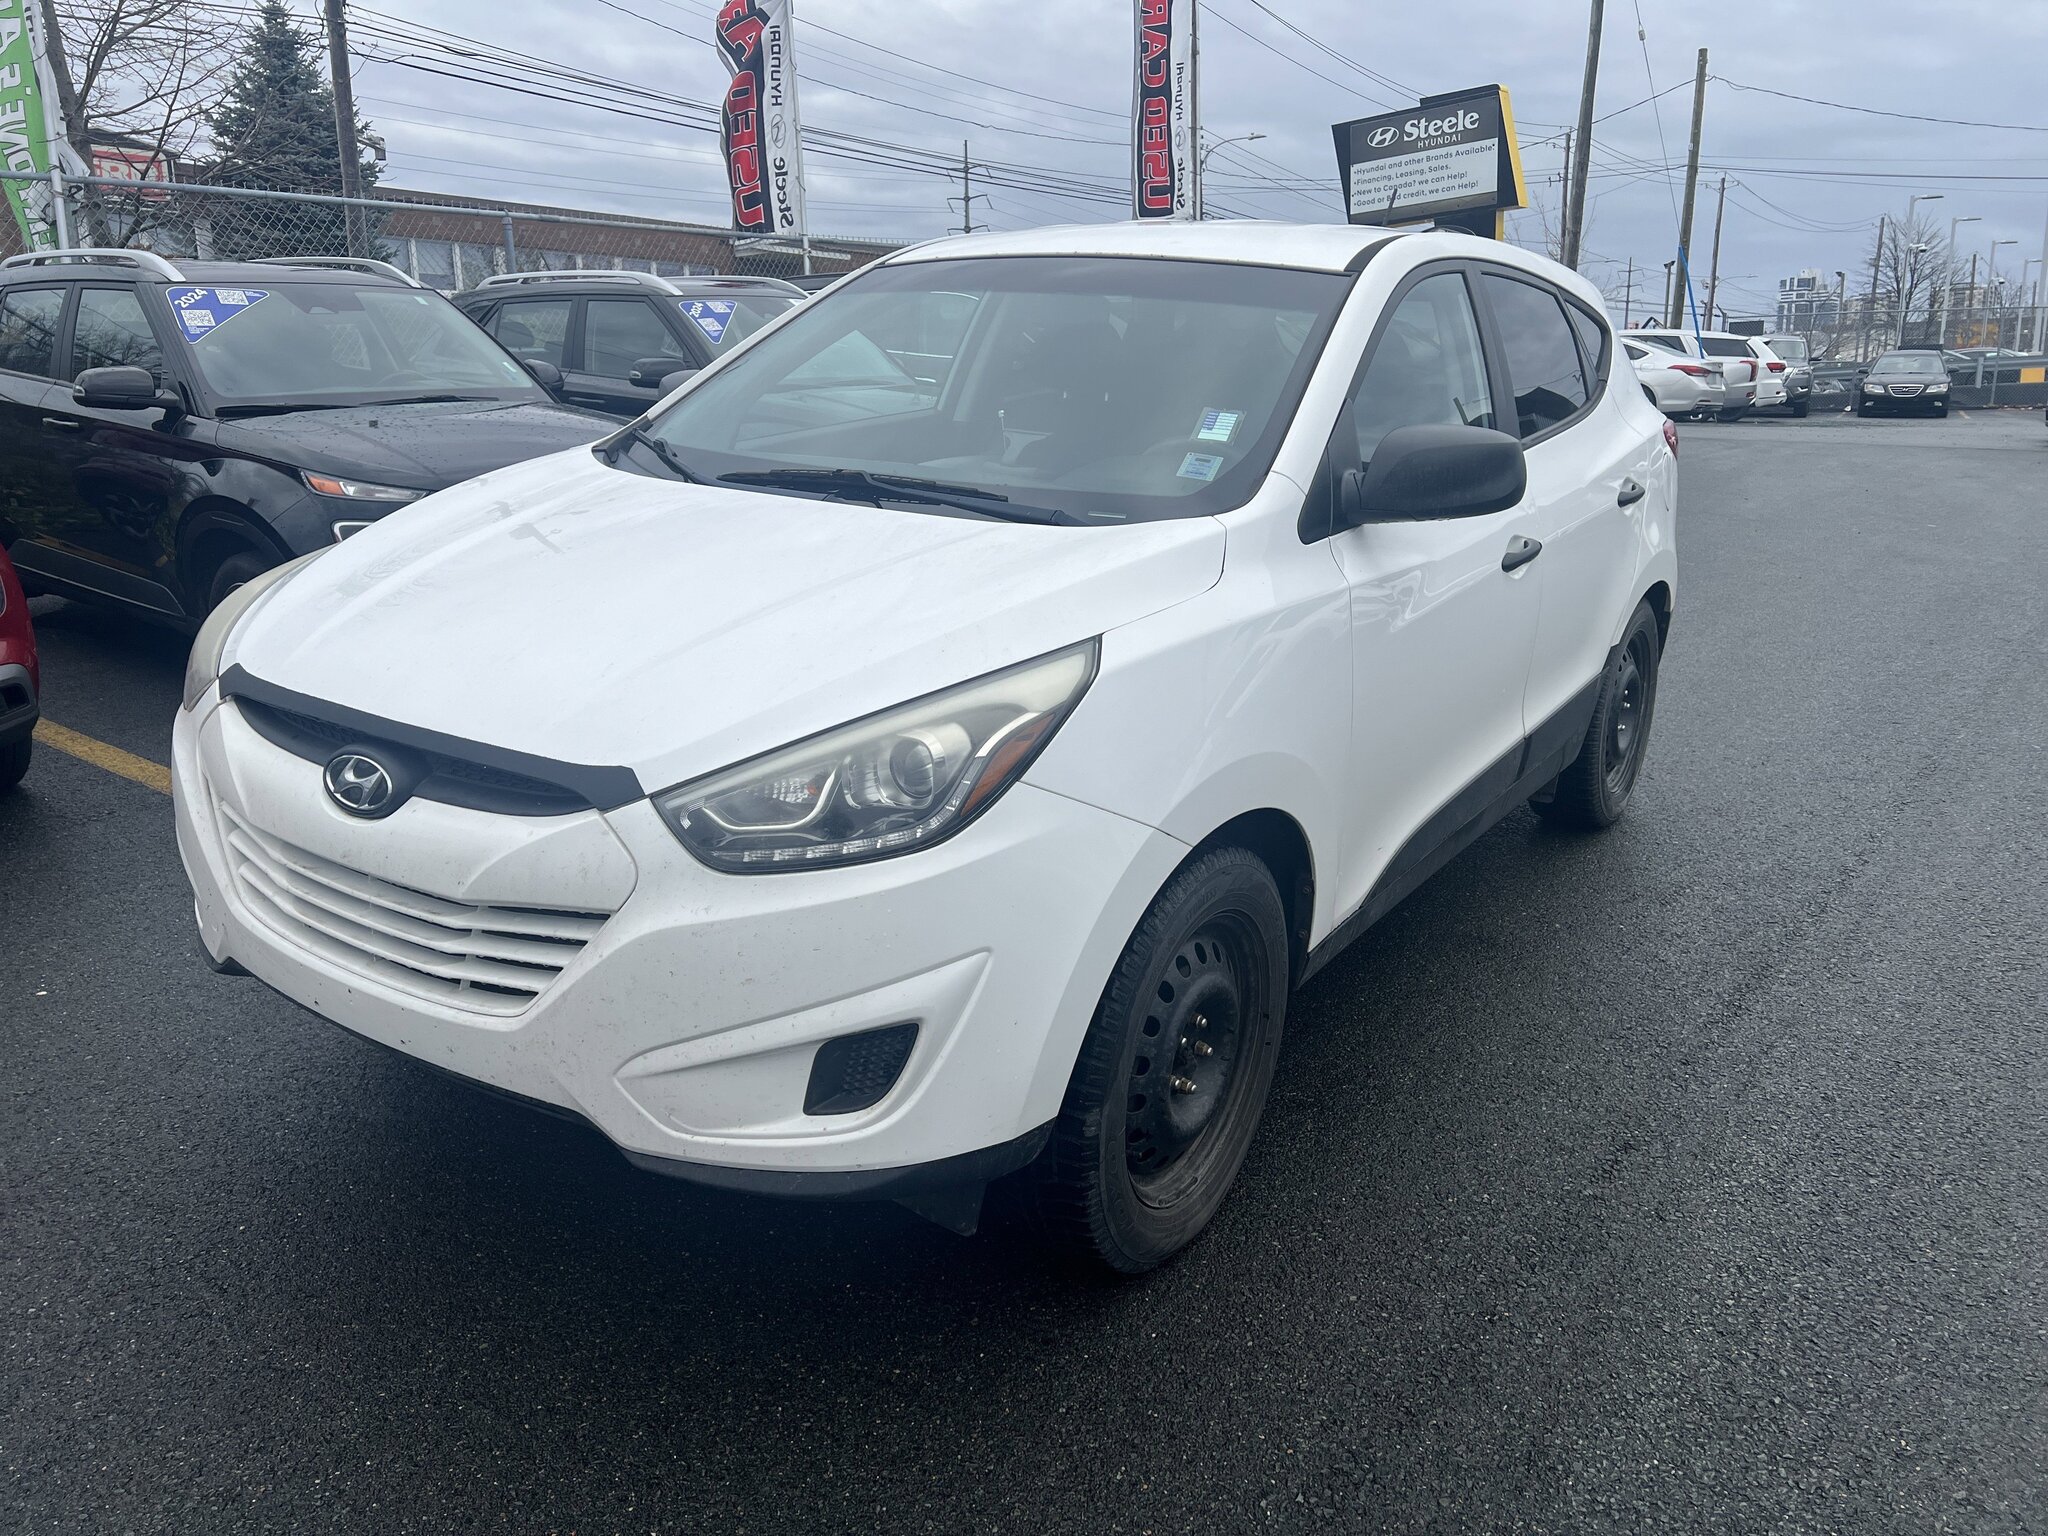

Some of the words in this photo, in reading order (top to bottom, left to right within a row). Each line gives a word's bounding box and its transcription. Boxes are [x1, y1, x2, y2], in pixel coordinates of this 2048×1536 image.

[1403, 109, 1480, 142] Steele
[1417, 133, 1461, 149] HYUNDAI
[1388, 161, 1403, 170] and
[1404, 158, 1424, 167] other
[1426, 152, 1453, 162] Brands
[1395, 169, 1427, 179] Leasing,
[1428, 164, 1451, 173] Sales.
[1431, 175, 1445, 183] can
[1447, 171, 1468, 180] Help!
[1387, 193, 1401, 202] Bd
[1403, 190, 1427, 199] credit,
[1457, 180, 1479, 190] Help!
[174, 288, 209, 309] 2024
[688, 302, 704, 318] 2024
